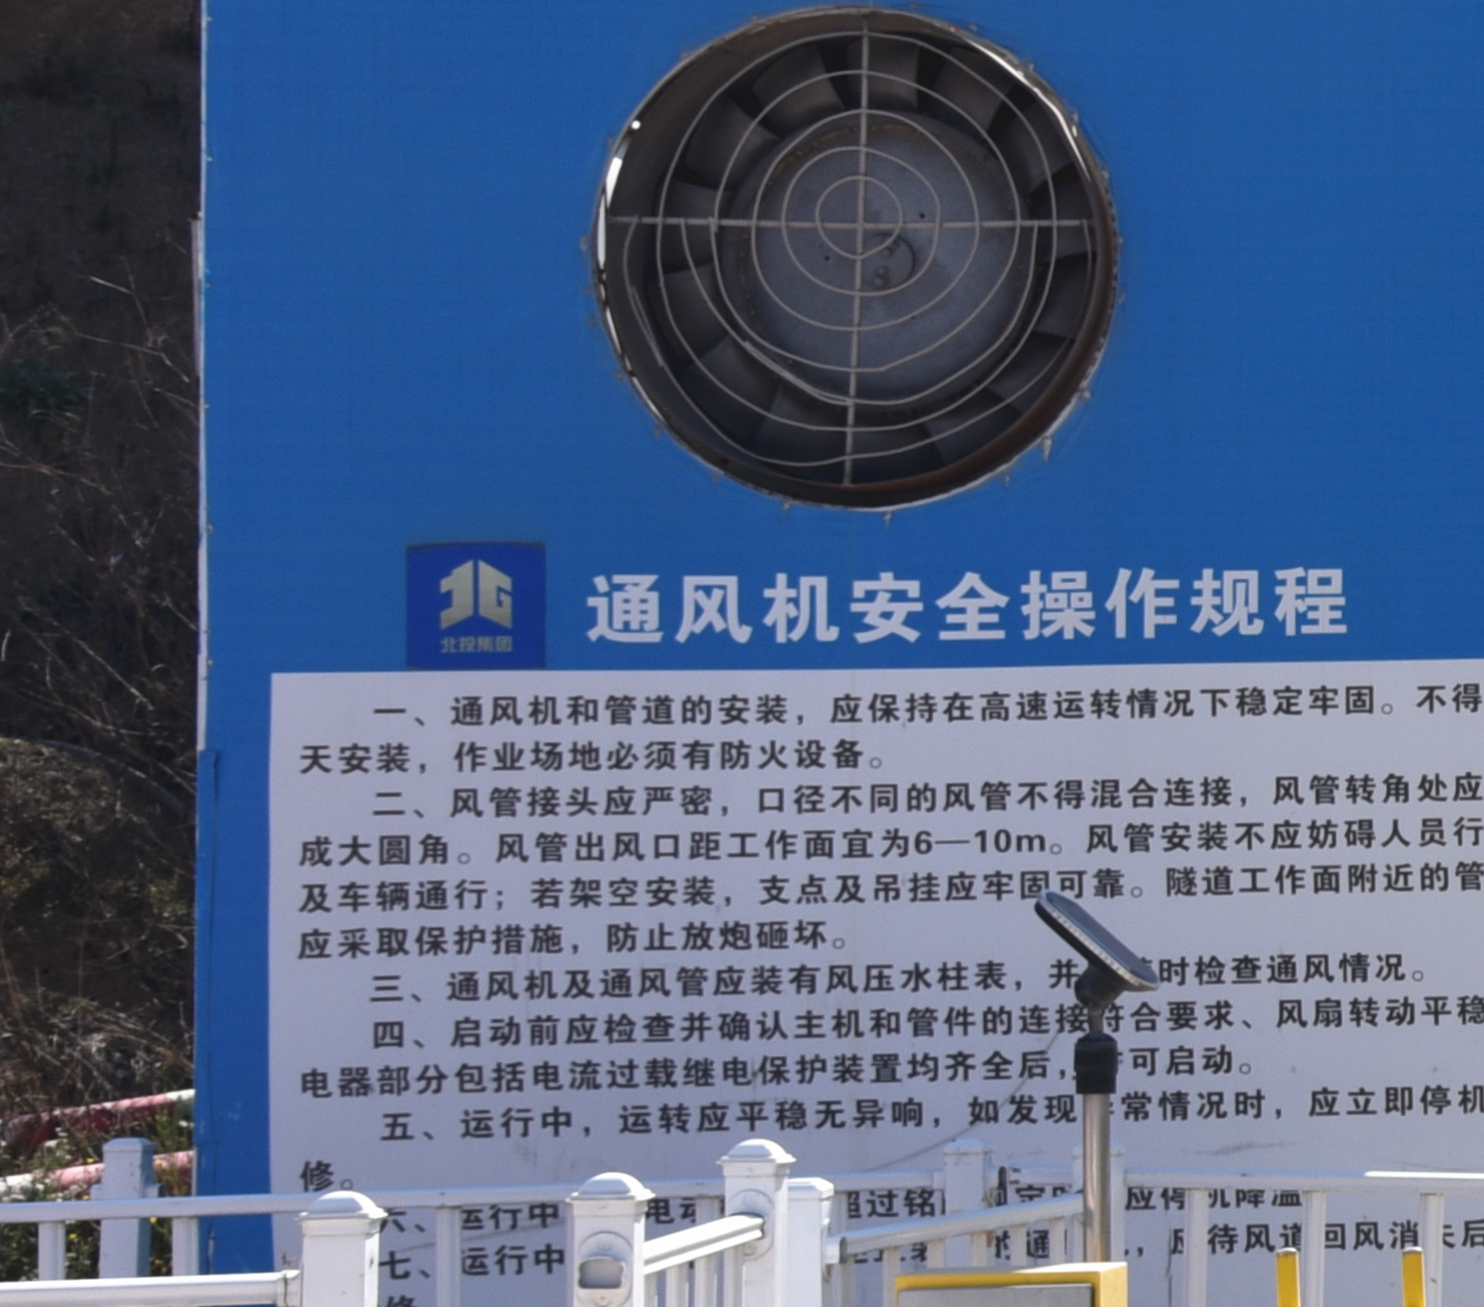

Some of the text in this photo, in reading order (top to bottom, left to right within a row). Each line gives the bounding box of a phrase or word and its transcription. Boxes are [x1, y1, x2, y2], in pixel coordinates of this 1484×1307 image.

[586, 567, 1348, 644] 通风机安全操作规程
[440, 635, 512, 653] 北投集团
[370, 952, 1426, 1003] 三、通风机及通风管应装有风压水柱表，并时检查通风情况。
[301, 1044, 1252, 1098] 电器部分包括电流过载继电保护装置均齐全后，可启动。
